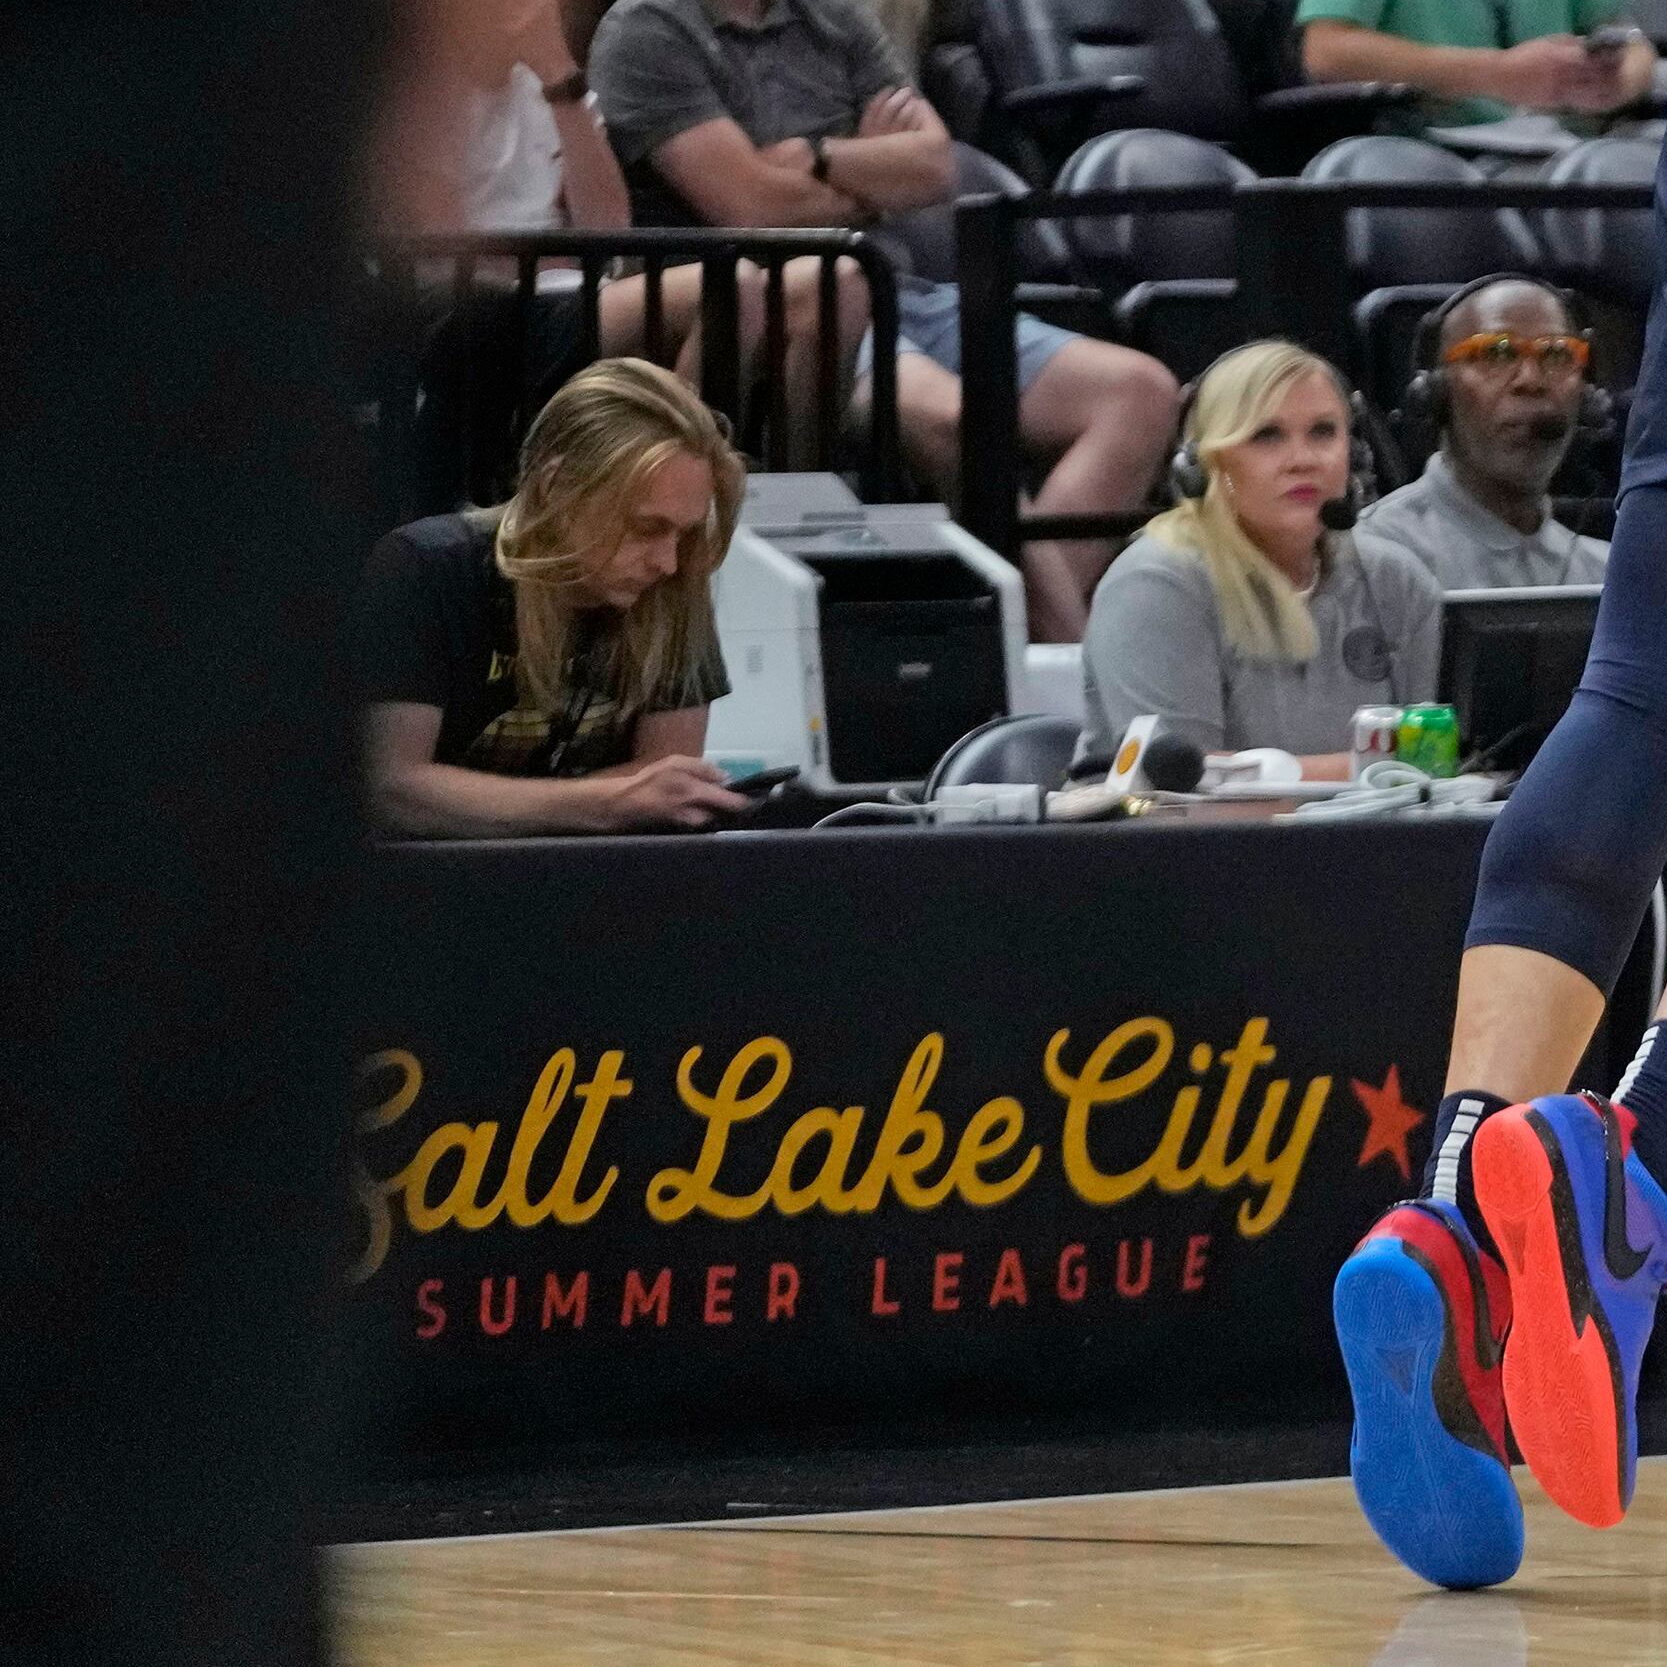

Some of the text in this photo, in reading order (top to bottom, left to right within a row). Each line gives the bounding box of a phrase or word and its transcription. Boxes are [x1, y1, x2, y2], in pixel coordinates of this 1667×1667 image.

[645, 1032, 1041, 1223] Lake
[1044, 1015, 1333, 1237] City
[415, 1234, 1212, 1340] SUMMER LEAGUE
